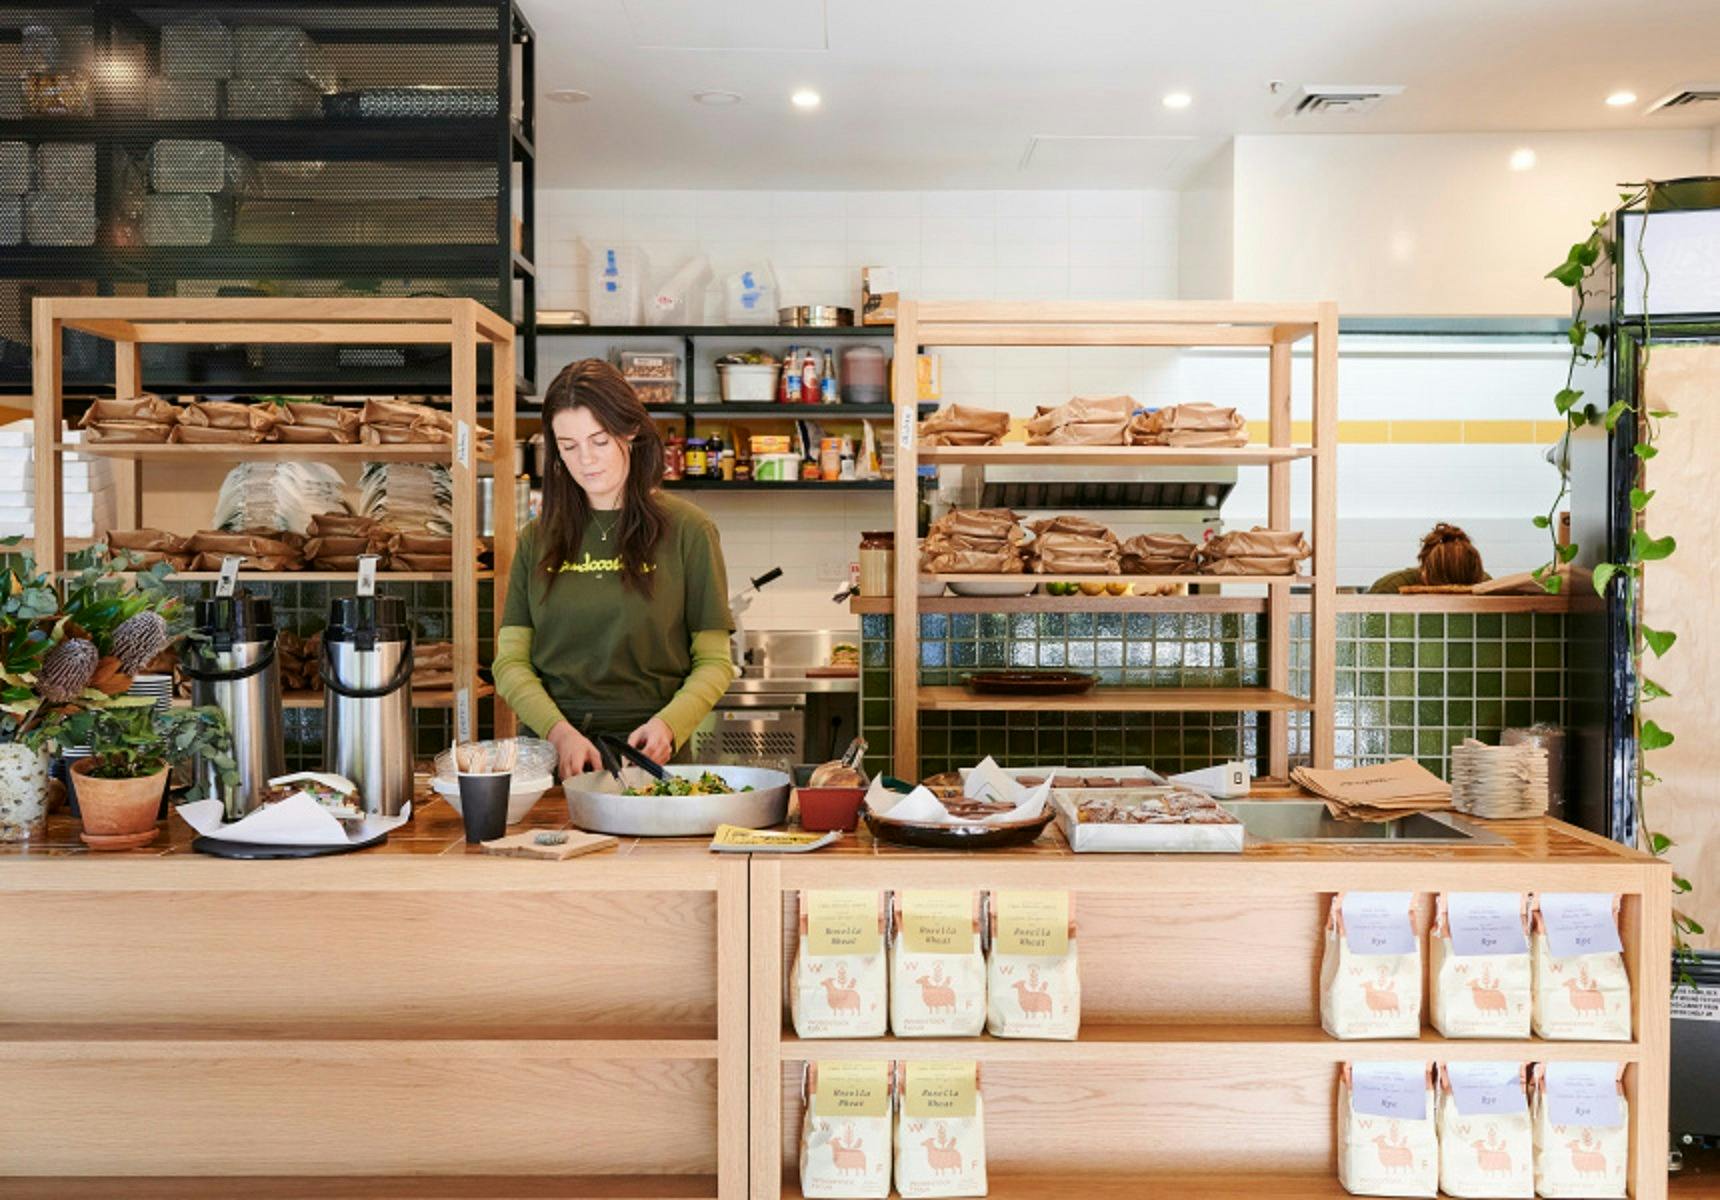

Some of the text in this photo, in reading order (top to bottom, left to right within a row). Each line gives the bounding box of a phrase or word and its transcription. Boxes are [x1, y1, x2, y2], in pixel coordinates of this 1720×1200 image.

[1370, 937, 1387, 946] Rye
[1480, 937, 1498, 947] Rye
[1574, 936, 1592, 946] Rye
[1381, 1098, 1398, 1109] Rye
[1481, 1095, 1497, 1105] Rye
[1575, 1106, 1591, 1117] Rye
